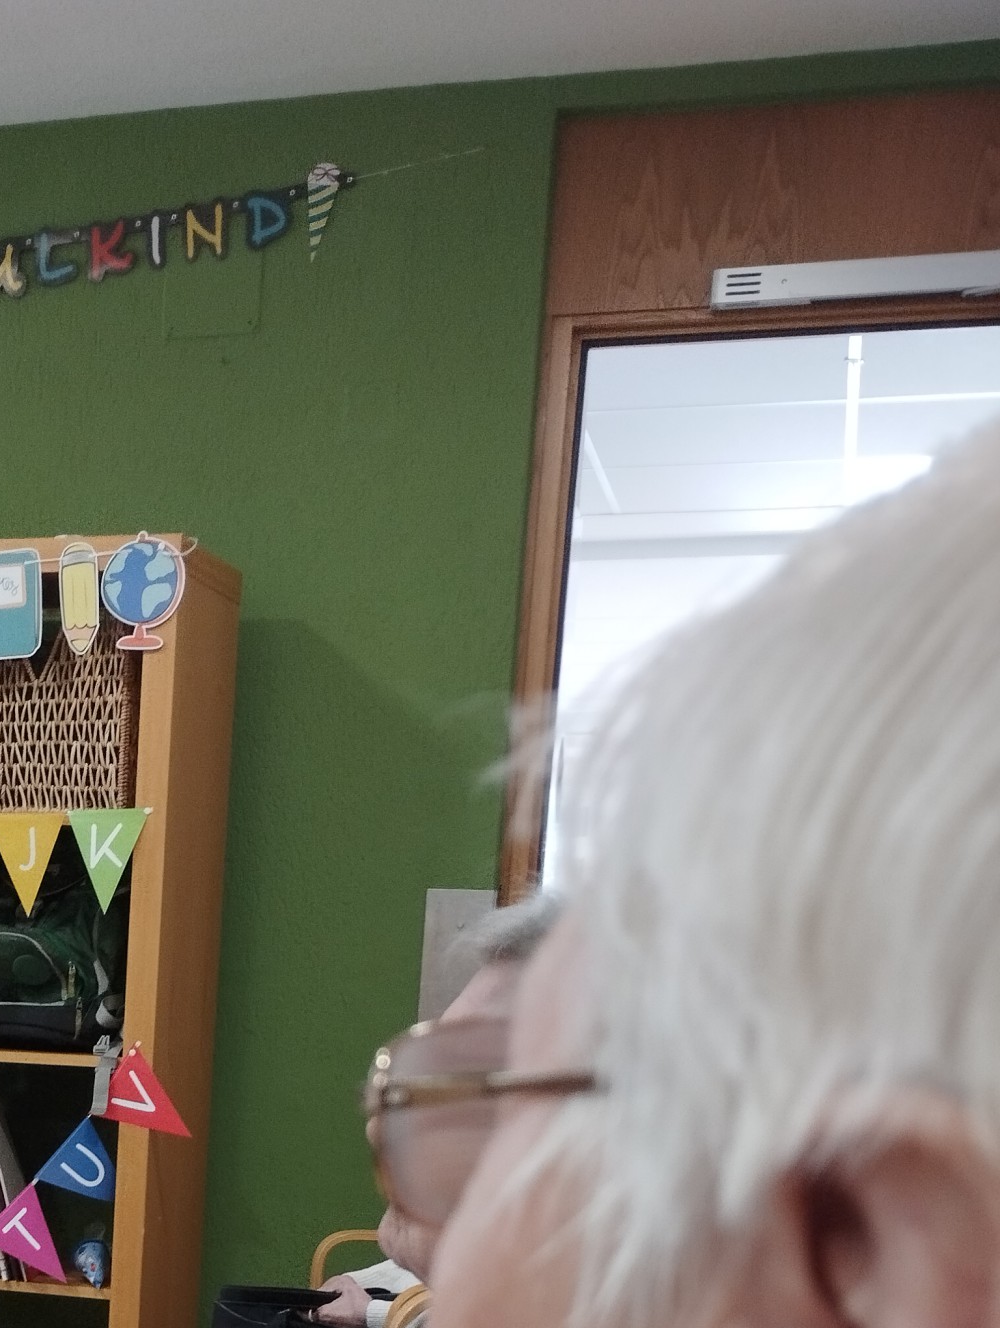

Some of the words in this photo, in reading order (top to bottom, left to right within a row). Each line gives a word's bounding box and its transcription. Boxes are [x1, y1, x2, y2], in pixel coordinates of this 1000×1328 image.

[18, 826, 37, 872] J
[89, 822, 123, 869] K
[1, 1206, 42, 1251] T
[60, 1142, 106, 1188] U
[110, 1069, 156, 1113] V
